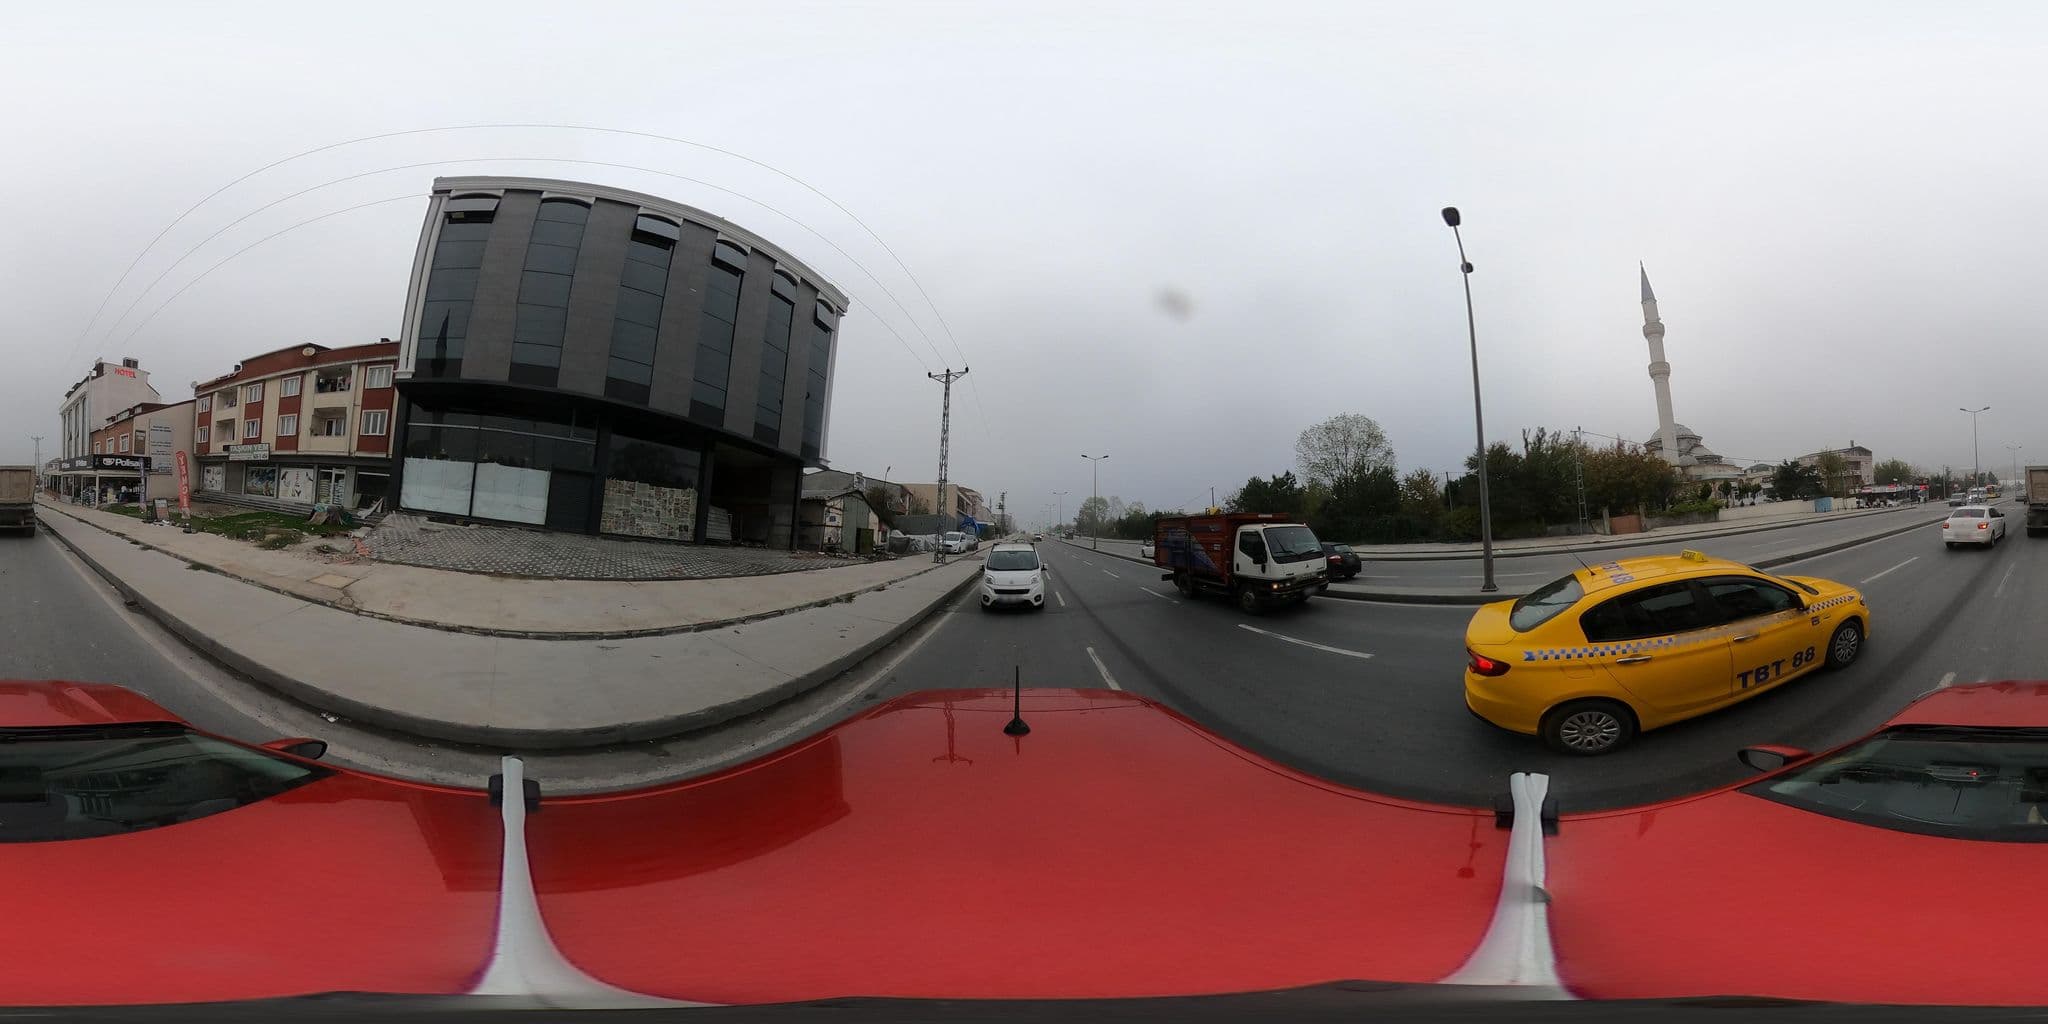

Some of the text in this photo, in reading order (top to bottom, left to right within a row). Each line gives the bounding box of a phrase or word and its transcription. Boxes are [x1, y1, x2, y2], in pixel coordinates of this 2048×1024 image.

[114, 367, 136, 379] HOTEL
[115, 458, 141, 467] Polisa
[1736, 646, 1816, 689] TBT 88
